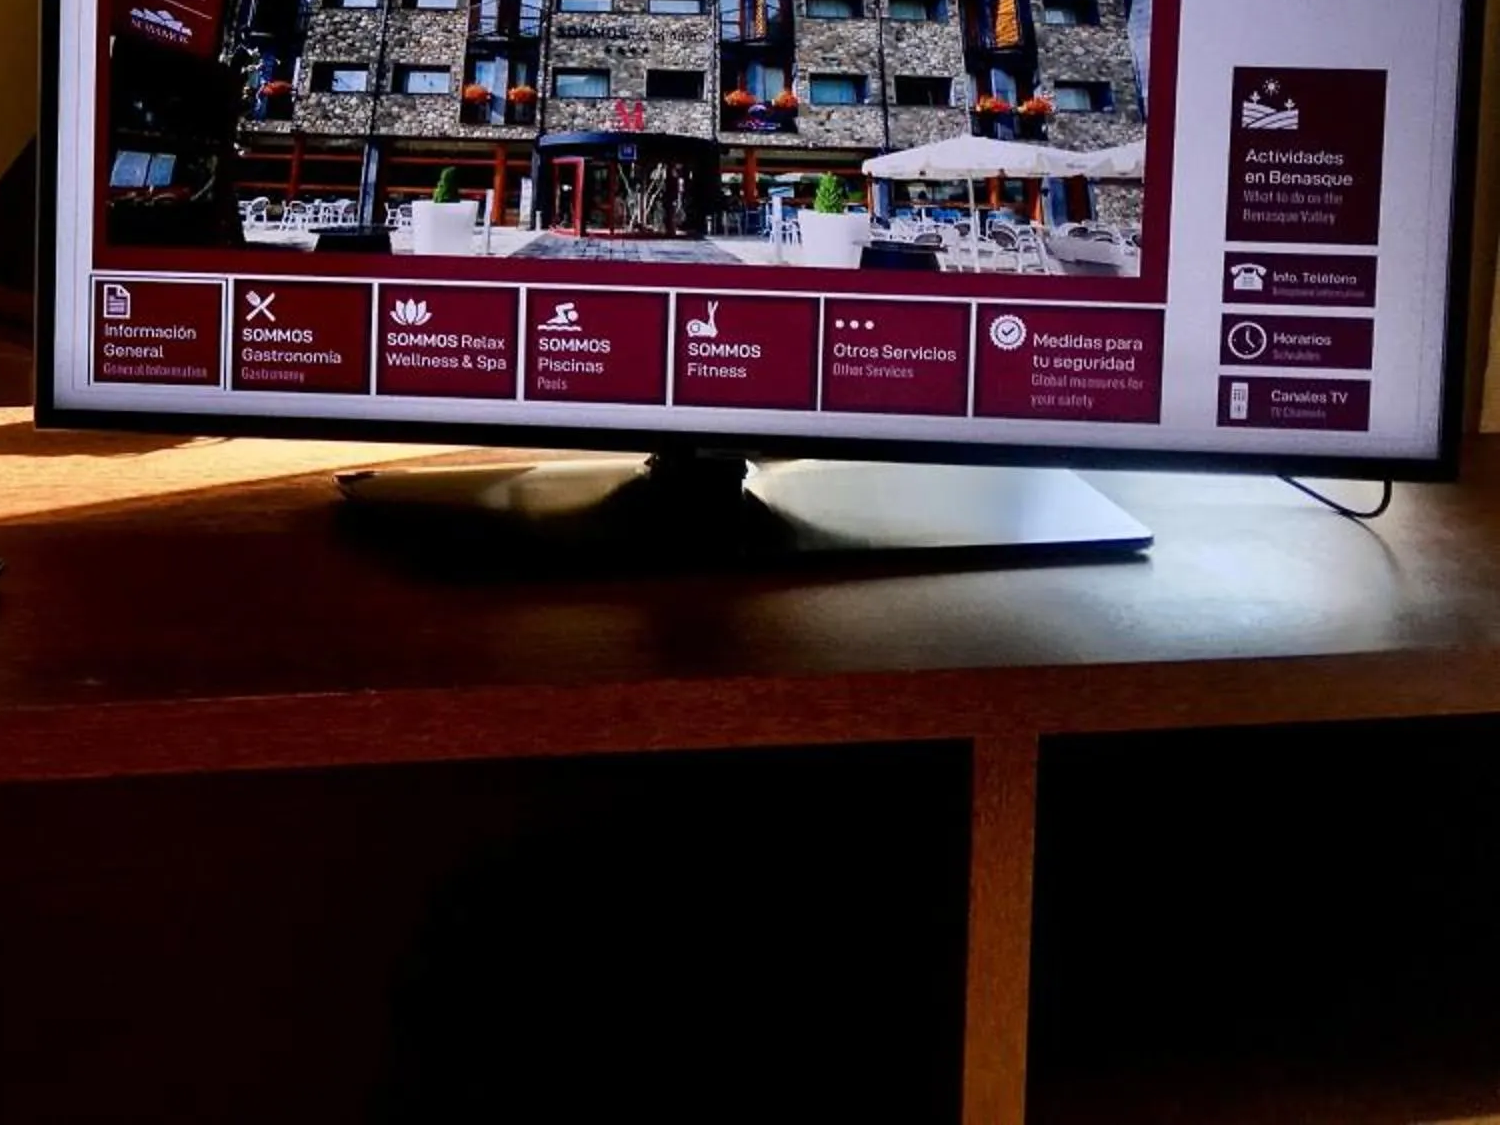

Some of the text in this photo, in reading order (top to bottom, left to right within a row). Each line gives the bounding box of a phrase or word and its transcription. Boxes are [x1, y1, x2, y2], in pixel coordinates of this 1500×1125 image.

[1245, 148, 1345, 165] Actividades
[1245, 170, 1354, 187] en Benasque
[104, 323, 197, 340] Información
[242, 328, 313, 344] SOMMOS
[1273, 332, 1332, 346] Horarios
[387, 332, 505, 350] SOMMOS Relax
[538, 337, 611, 354] SOMMOS
[1033, 333, 1143, 352] Medidas para
[103, 342, 164, 358] General
[241, 347, 342, 364] Gastronomía
[687, 342, 762, 359] SOMMOS
[833, 342, 957, 361] Otros Servicios
[386, 352, 507, 371] Wellness & Spa
[537, 357, 604, 373] Piscinas
[687, 362, 747, 378] Fitness
[833, 362, 914, 378] Other Services
[1033, 355, 1136, 372] tu seguridad
[1031, 373, 1067, 387] Global
[1030, 394, 1093, 409] your safety
[1271, 388, 1349, 404] Canales TV
